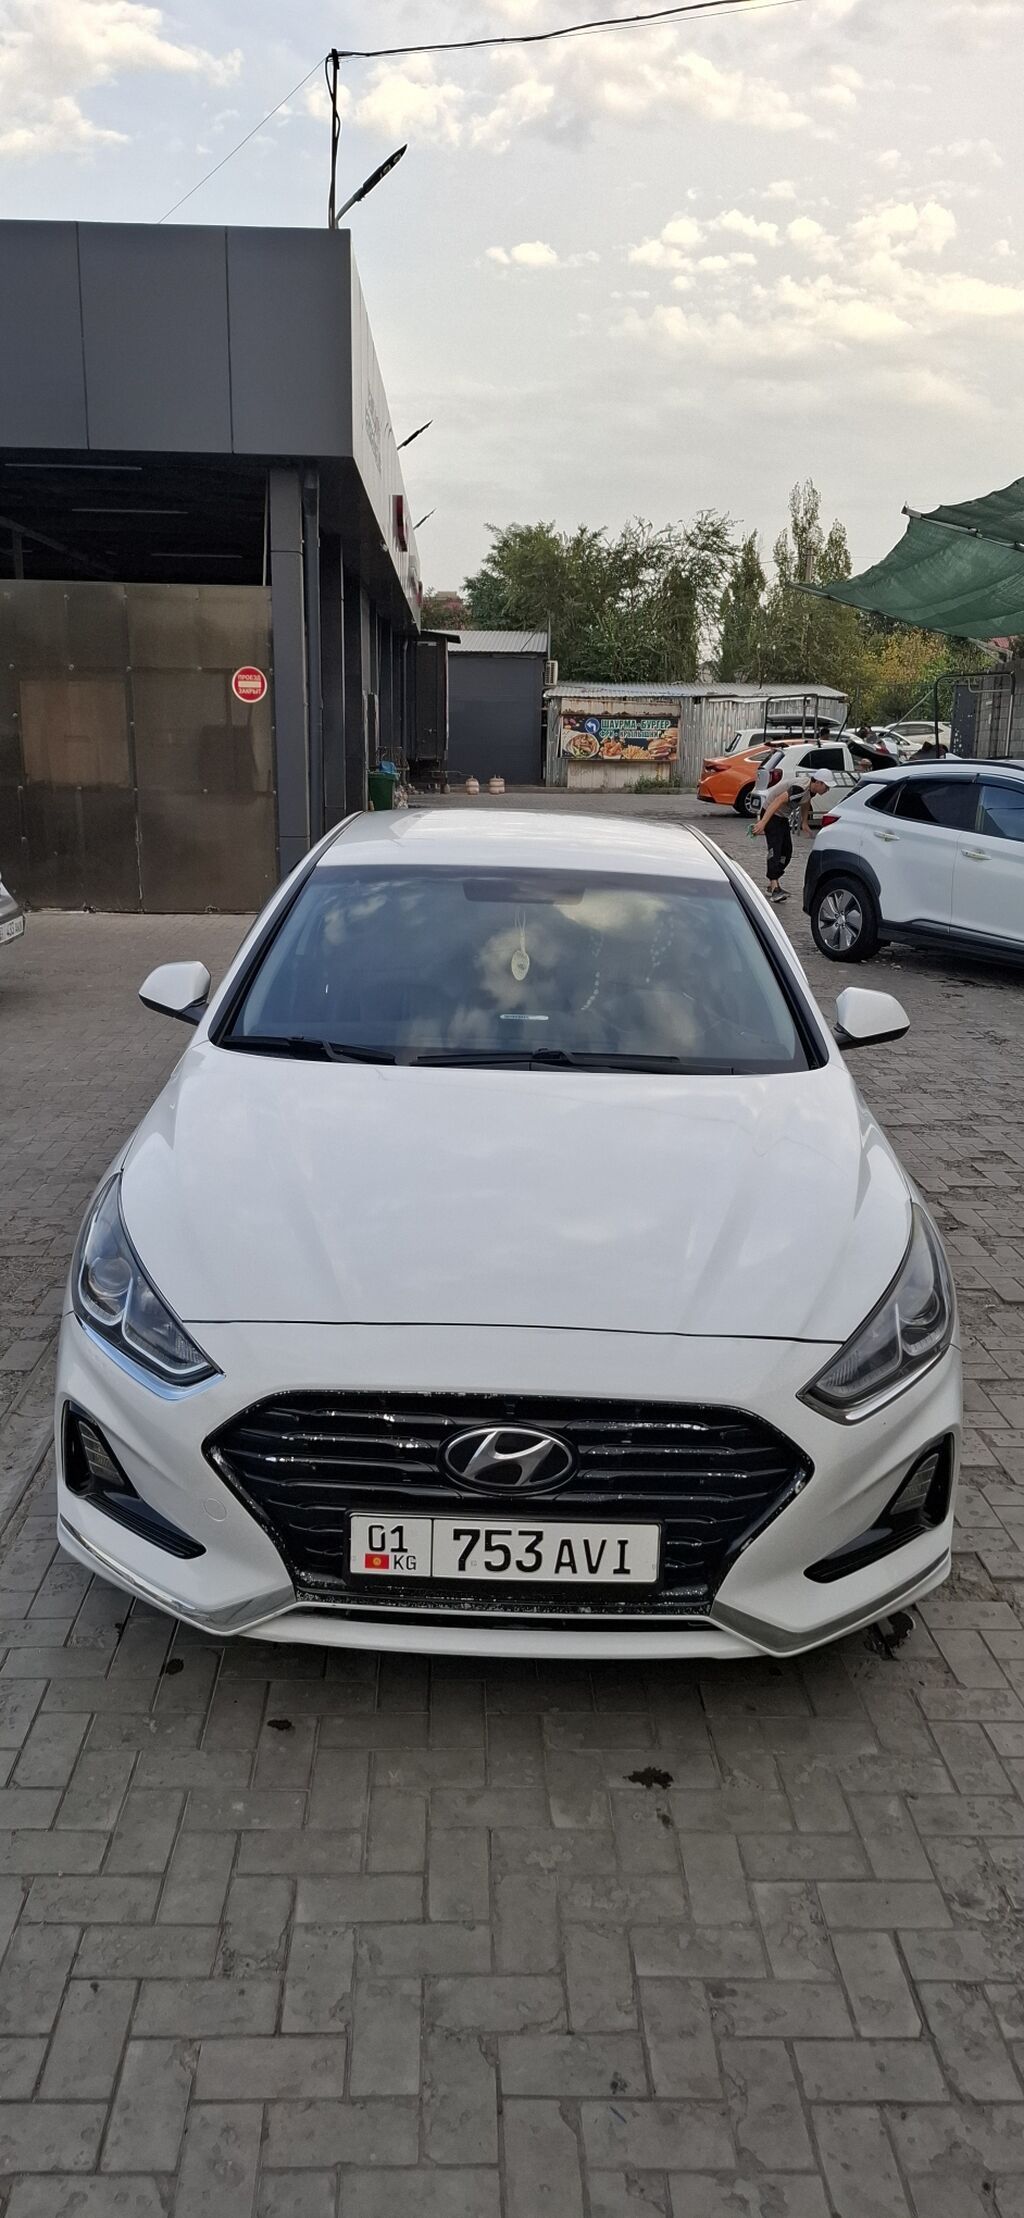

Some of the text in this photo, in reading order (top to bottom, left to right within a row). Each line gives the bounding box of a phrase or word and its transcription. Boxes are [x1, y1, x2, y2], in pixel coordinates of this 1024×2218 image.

[601, 719, 637, 730] ШАУРМА
[368, 1524, 631, 1575] 01 753 AVI
[393, 1554, 417, 1571] KG
